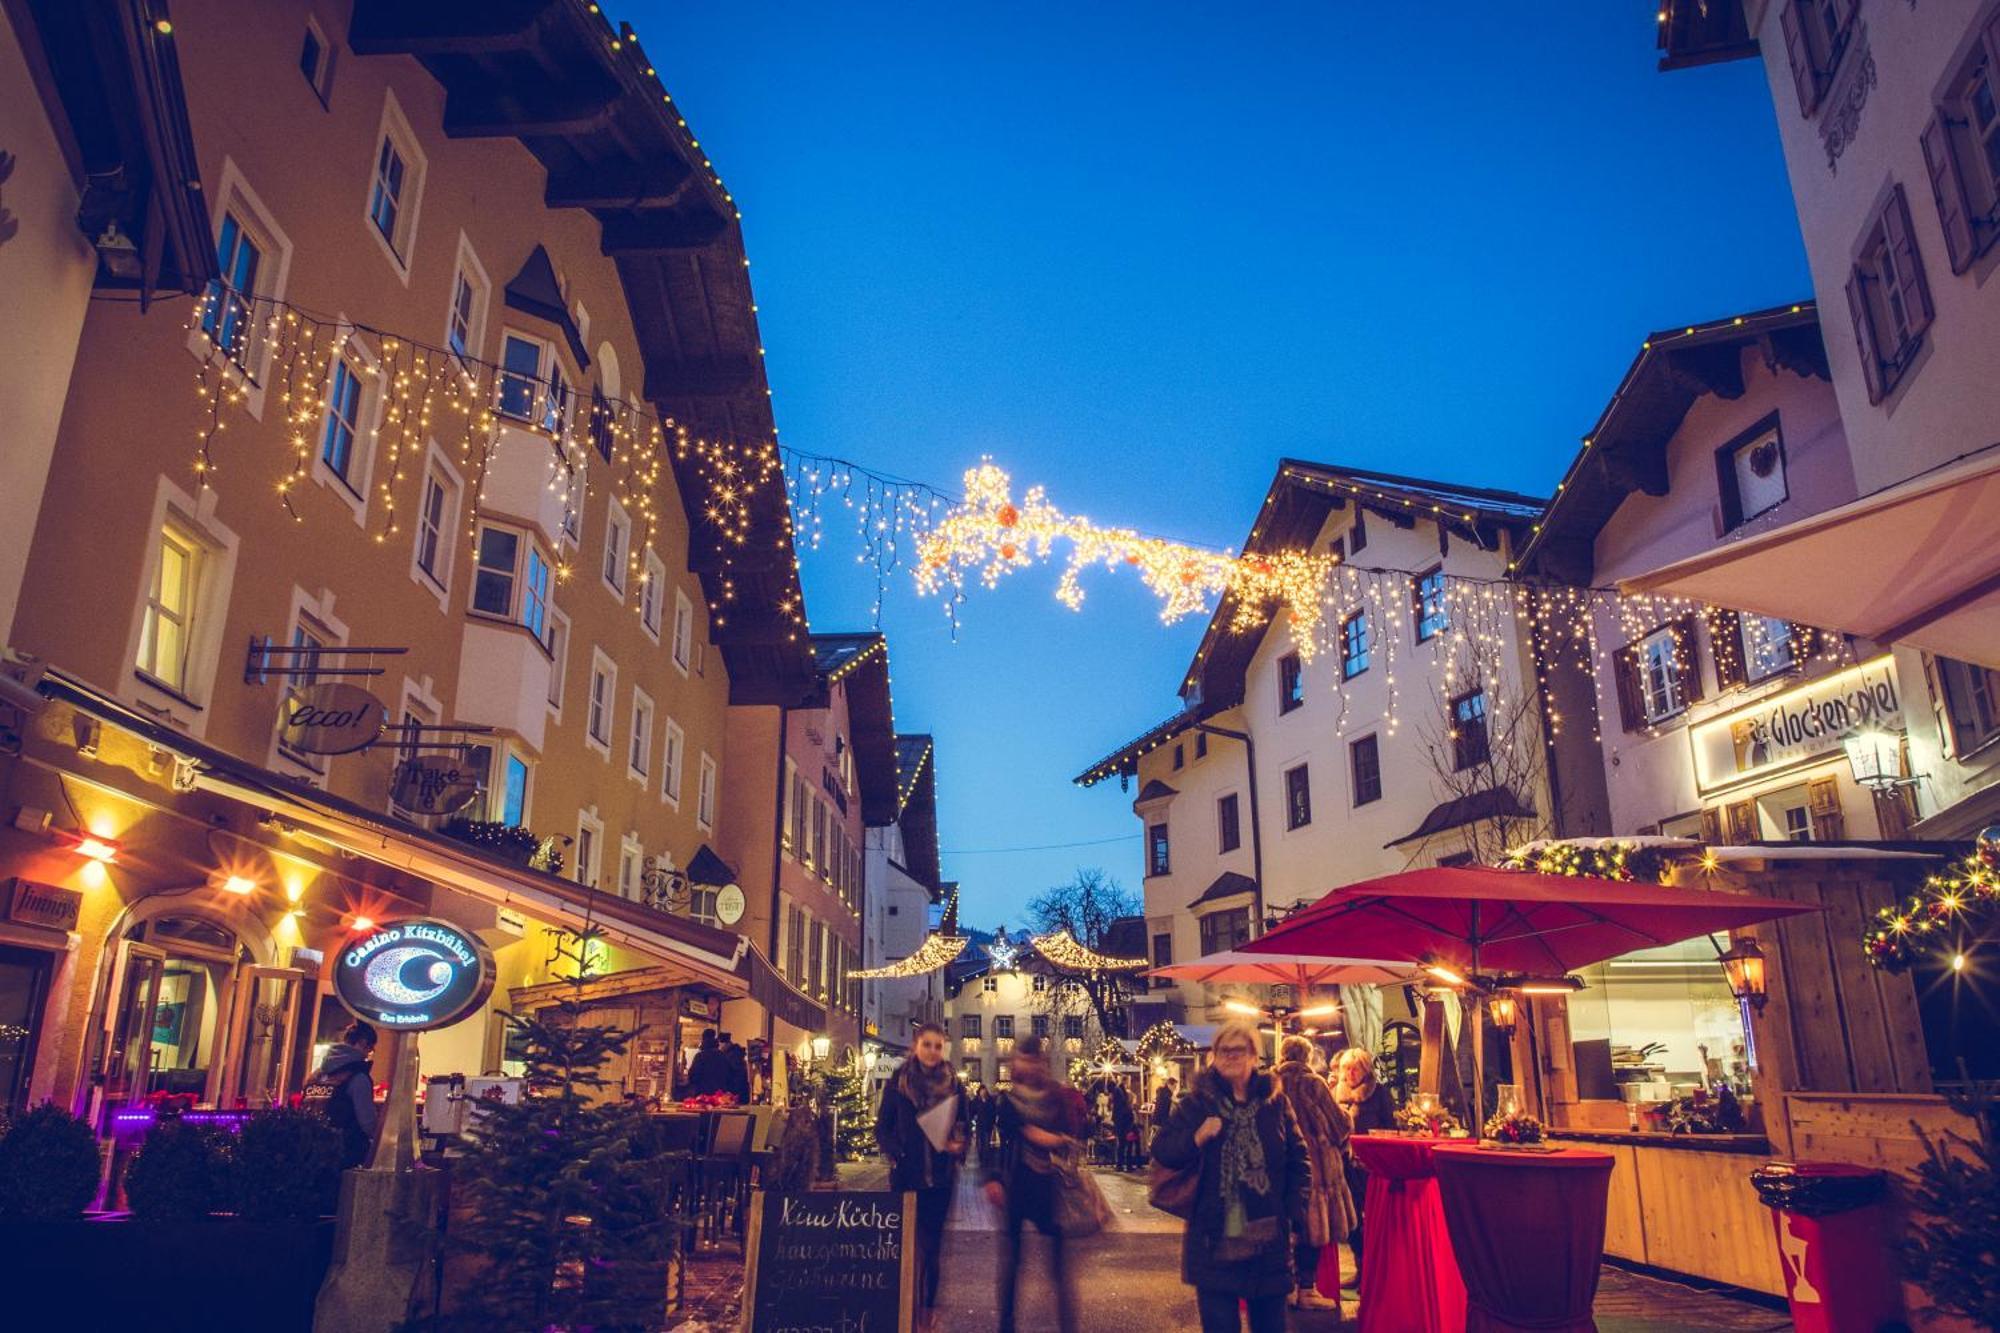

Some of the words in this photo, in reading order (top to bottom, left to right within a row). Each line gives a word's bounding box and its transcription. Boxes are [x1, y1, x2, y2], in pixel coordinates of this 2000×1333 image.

[289, 704, 370, 728] ecco!
[1771, 667, 1898, 746] Glockenspiel
[345, 930, 400, 968] Casino
[403, 925, 477, 968] Kitzbühel
